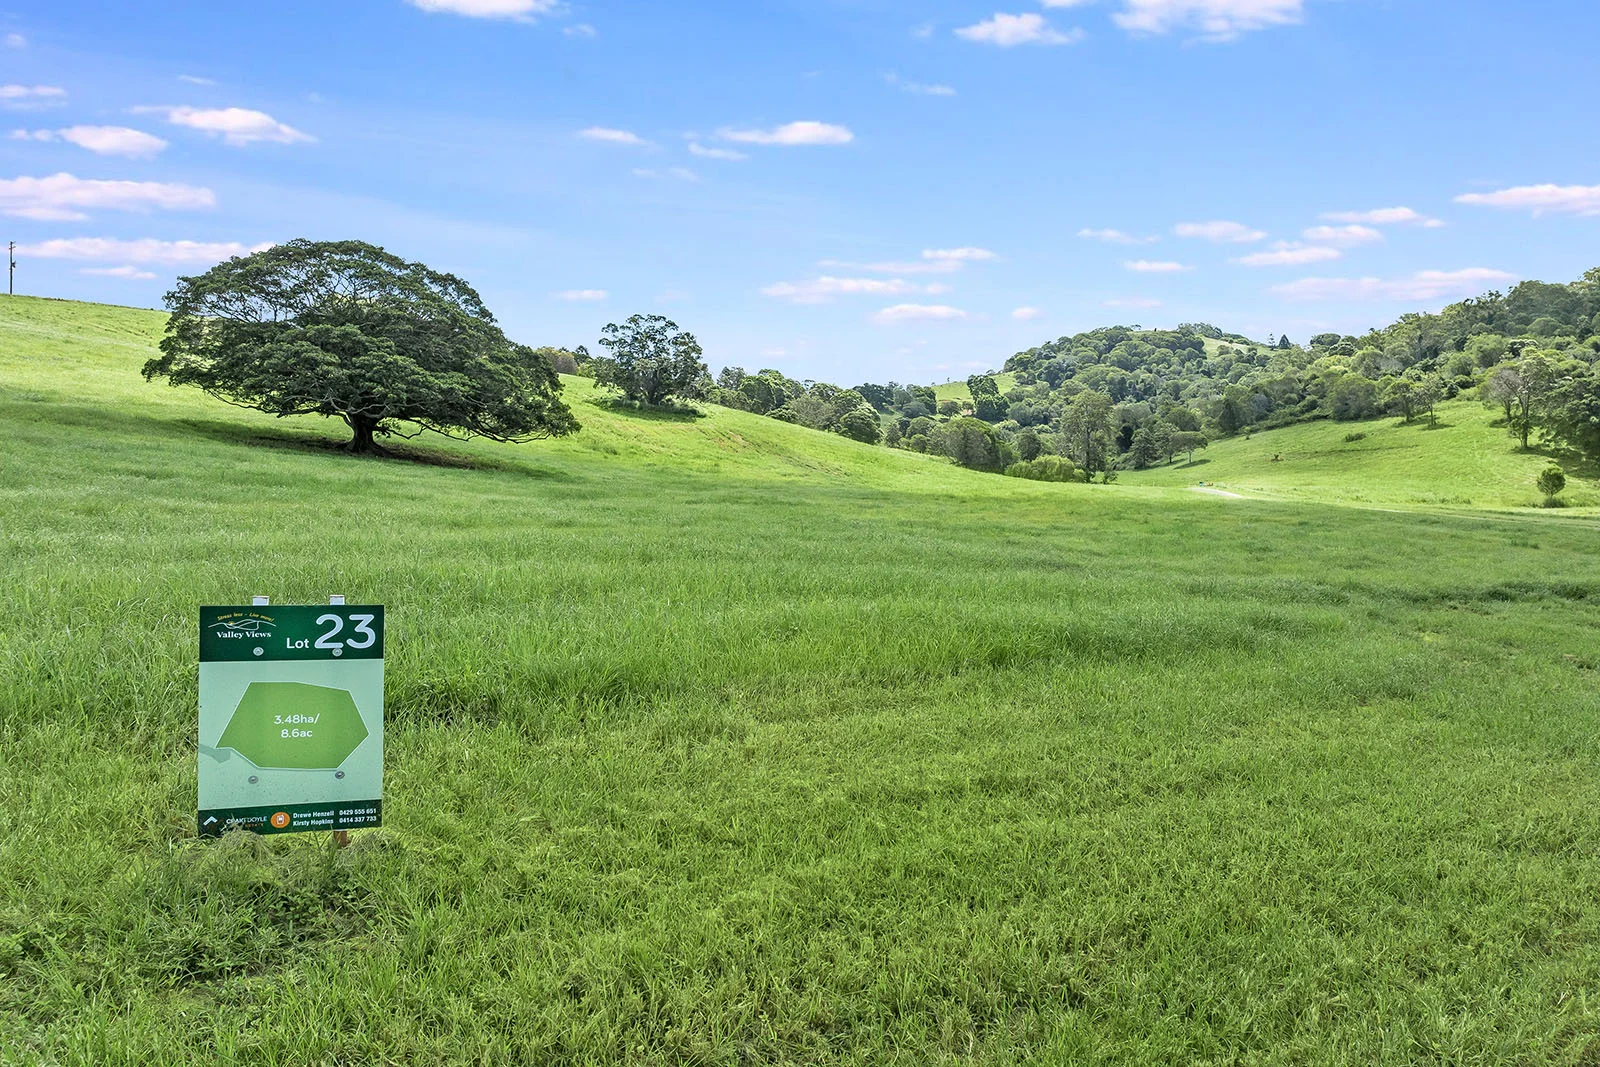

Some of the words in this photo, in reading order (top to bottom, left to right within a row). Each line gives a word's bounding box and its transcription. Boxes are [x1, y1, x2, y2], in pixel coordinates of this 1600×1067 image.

[217, 631, 243, 639] Valley
[286, 637, 310, 649] Lot
[314, 613, 376, 649] 23
[274, 713, 320, 724] 3.48ha/
[280, 728, 313, 739] 8.6ac
[312, 810, 335, 818] Henzell
[310, 818, 334, 826] Hopkins
